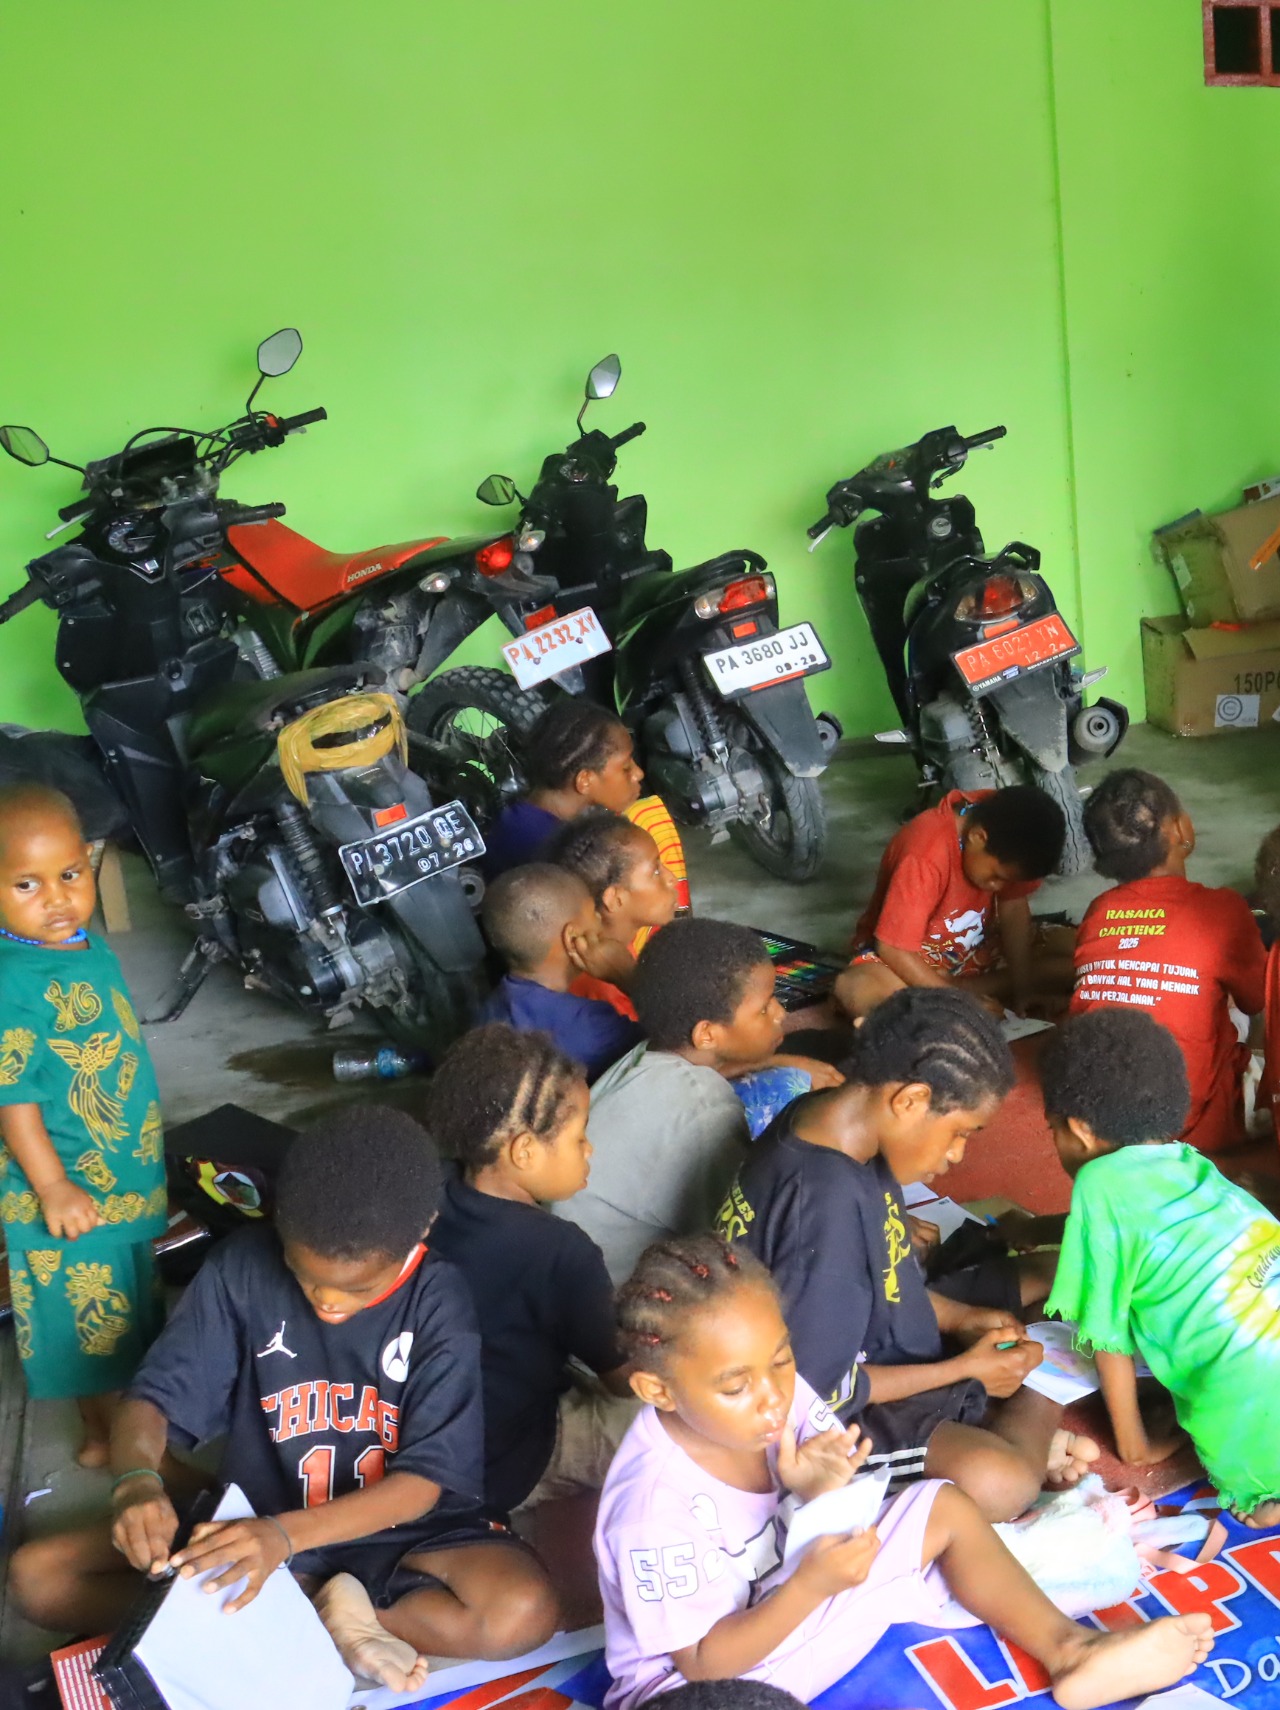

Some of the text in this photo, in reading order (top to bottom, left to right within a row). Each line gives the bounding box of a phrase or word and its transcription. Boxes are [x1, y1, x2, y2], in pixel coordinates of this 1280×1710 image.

[347, 563, 382, 583] HONDA
[574, 614, 599, 636] XY
[715, 631, 809, 674] PA 3680 JJ
[968, 651, 991, 672] PA
[978, 675, 1002, 690] YAMAHA
[374, 824, 433, 866] 3720
[1106, 908, 1165, 920] RASAKA
[1099, 925, 1166, 938] CARTENZ
[1118, 937, 1139, 950] 2025
[1118, 959, 1161, 973] MENCAPAI
[1087, 975, 1116, 985] BANYAK
[1117, 976, 1132, 987] HAL
[1135, 978, 1158, 990] YANG
[1160, 981, 1200, 995] MENARIK
[629, 1541, 700, 1602] 55
